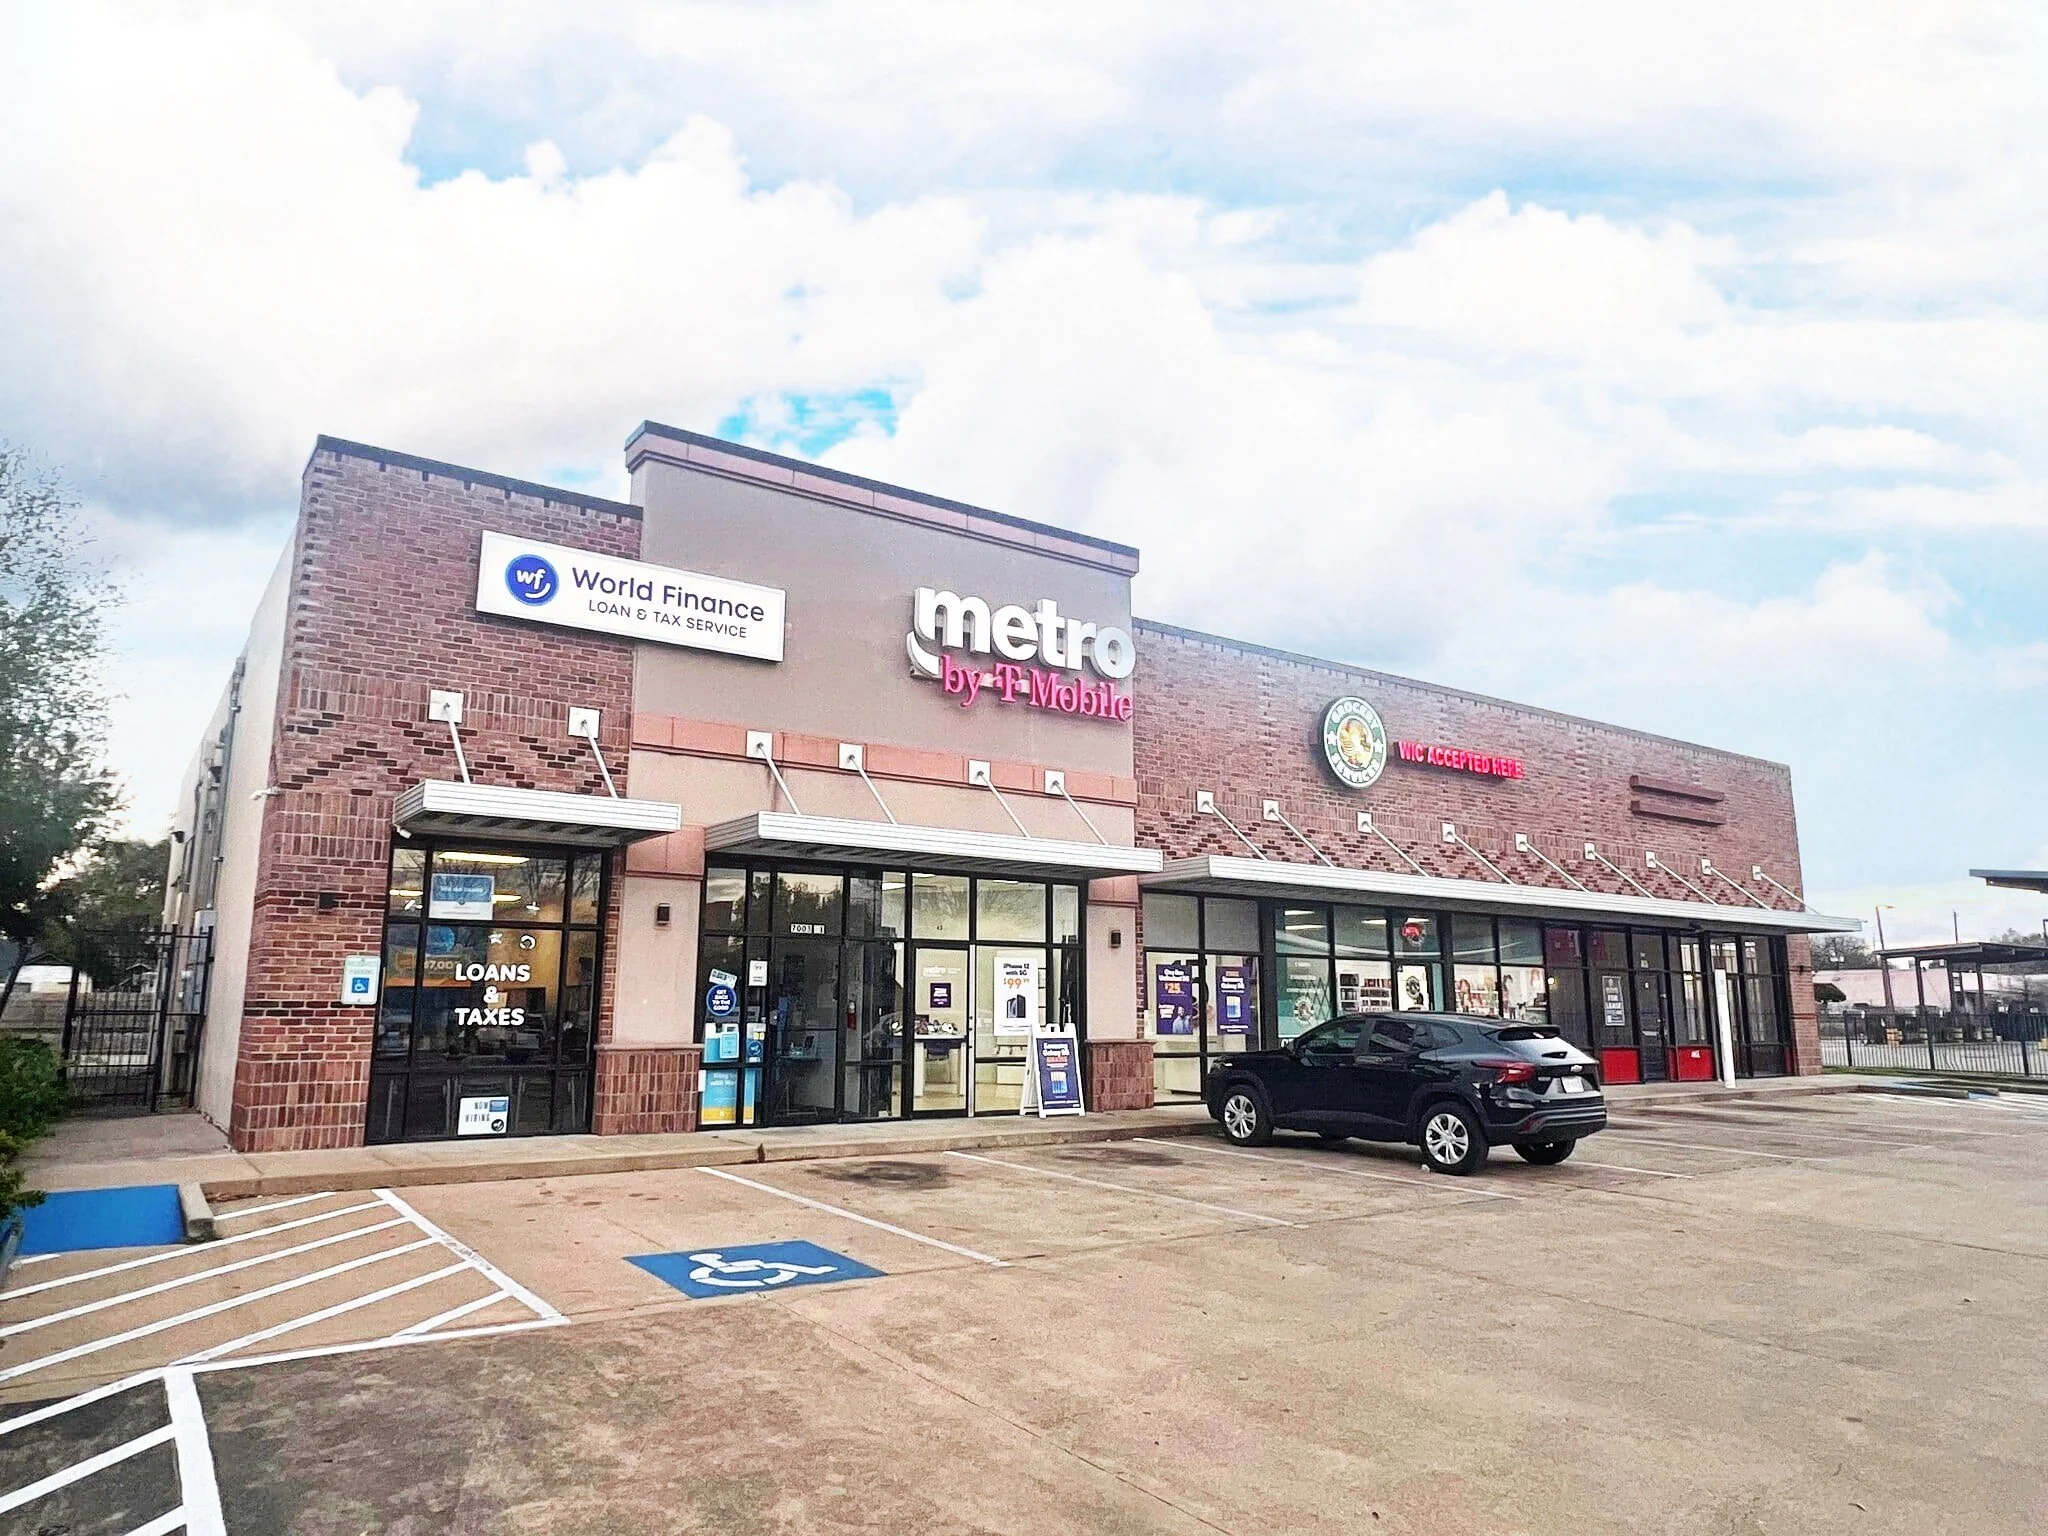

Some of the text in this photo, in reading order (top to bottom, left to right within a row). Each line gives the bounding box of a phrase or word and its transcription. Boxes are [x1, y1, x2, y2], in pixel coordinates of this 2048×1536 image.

[572, 567, 765, 622] World Finance
[588, 599, 747, 638] LOAN & TAX SERVICE
[914, 586, 1137, 679] metro
[941, 655, 985, 707] by
[1331, 700, 1379, 730] GROCERY
[1398, 740, 1525, 779] WIC ACCEPTED HERE
[454, 963, 531, 983] LOANS
[483, 986, 499, 1004] &
[454, 1008, 525, 1027] TAXES
